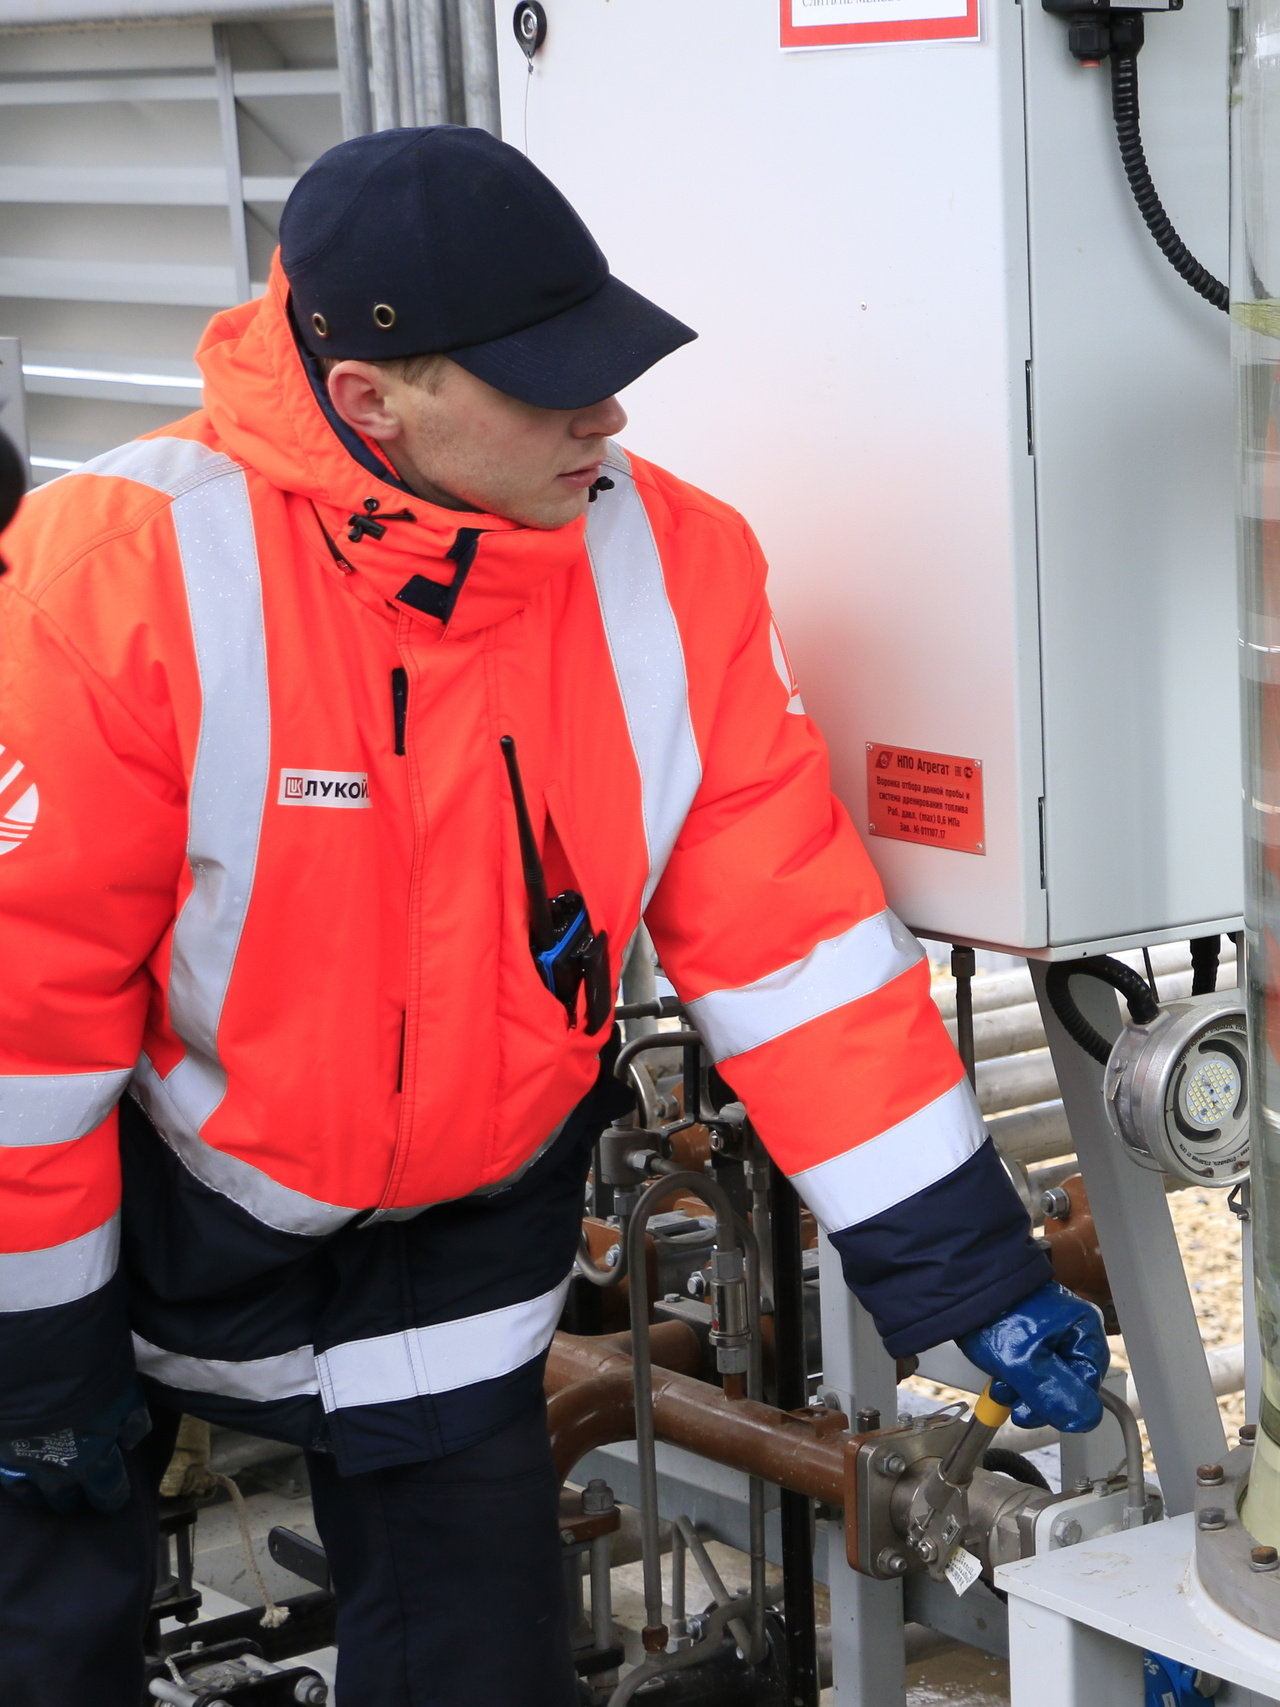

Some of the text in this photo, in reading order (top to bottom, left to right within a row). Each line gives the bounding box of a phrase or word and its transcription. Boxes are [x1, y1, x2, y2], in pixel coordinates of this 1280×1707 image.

[897, 755, 950, 775] НПО Агрегат
[877, 776, 900, 788] Воронка
[902, 780, 921, 792] отбора
[922, 783, 944, 795] донной
[945, 787, 965, 799] пробы
[879, 791, 969, 815] система дренирования топлива
[947, 817, 961, 828] МПа
